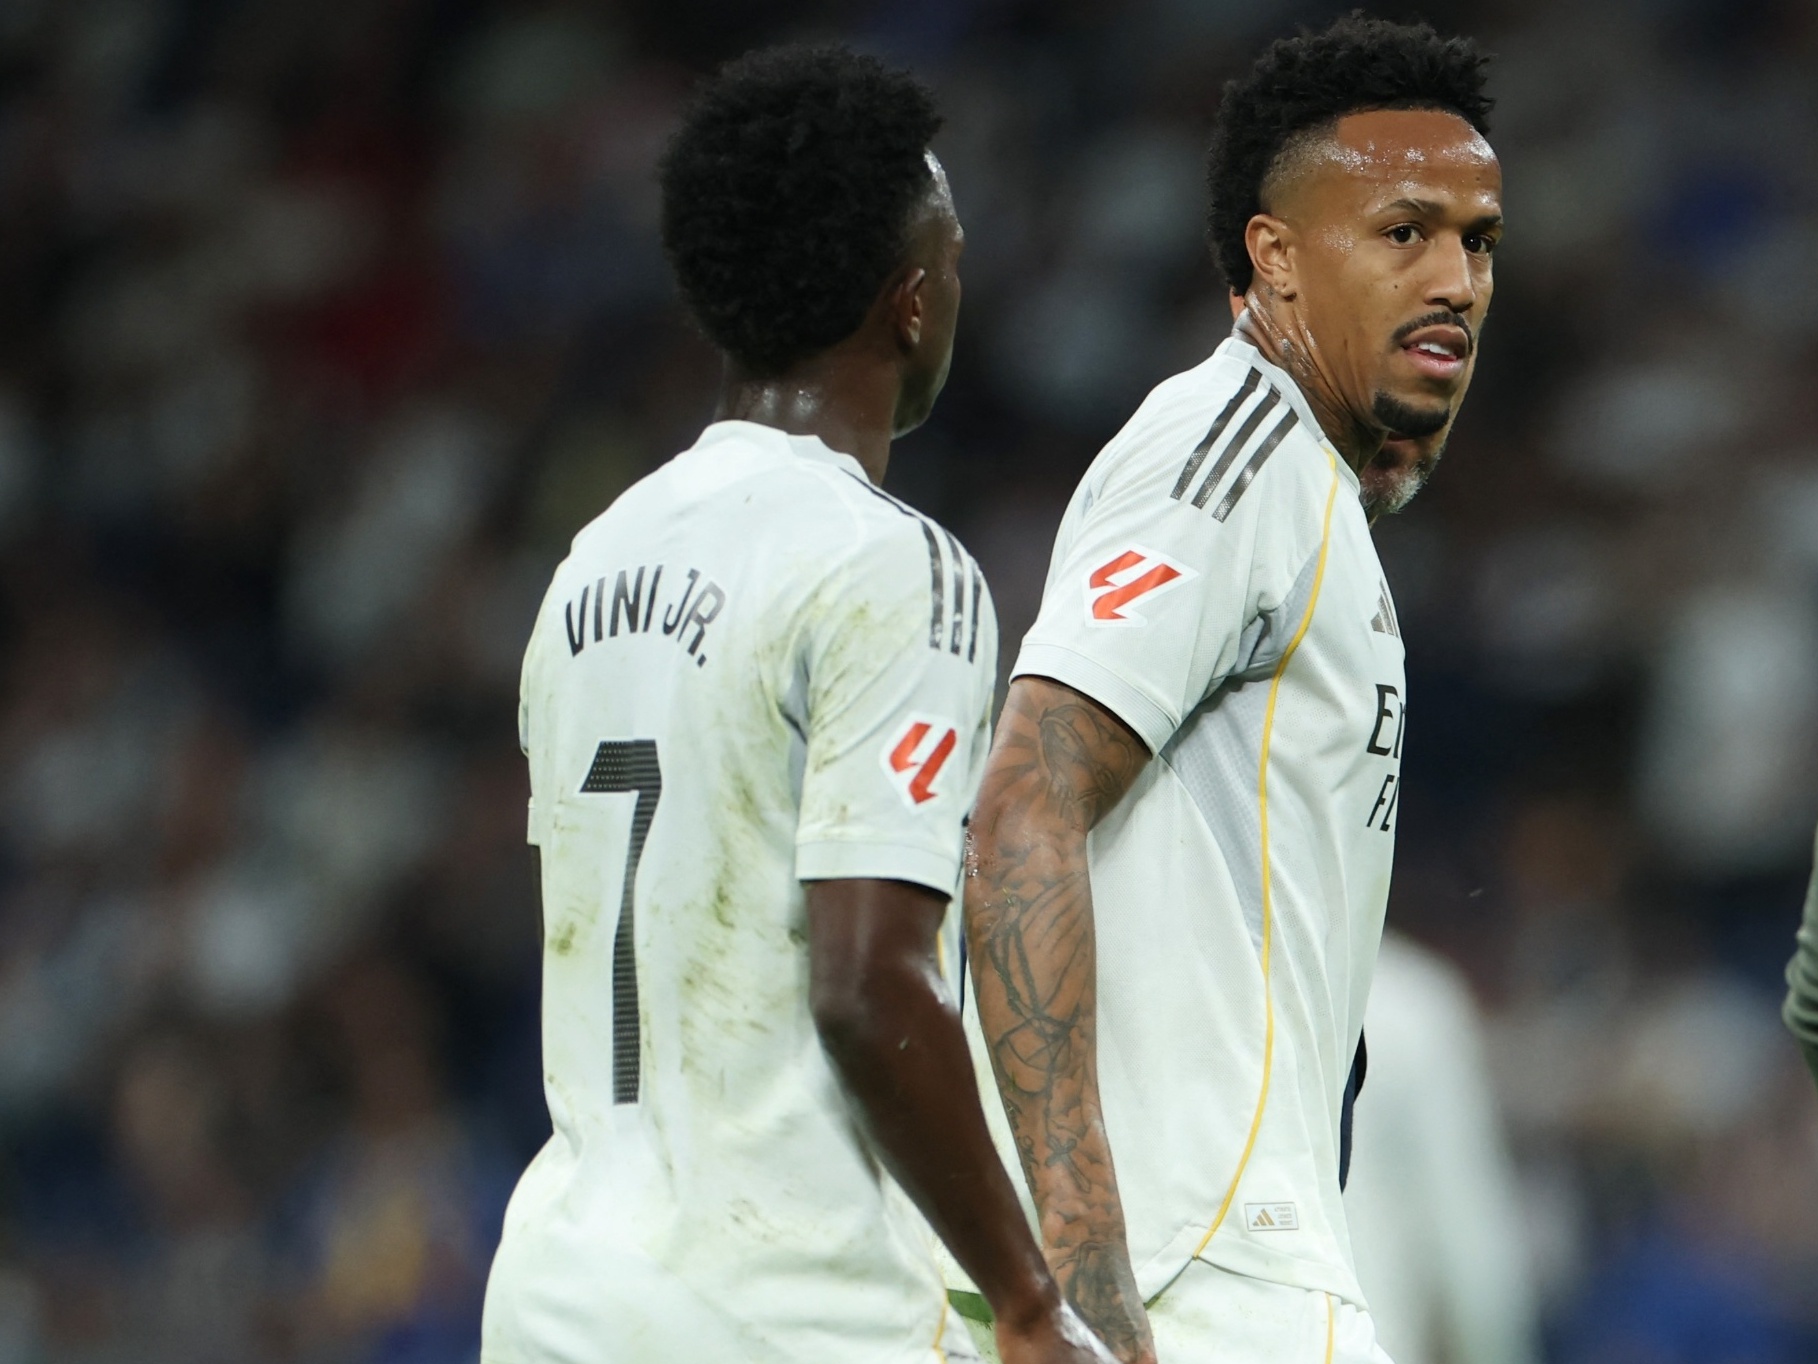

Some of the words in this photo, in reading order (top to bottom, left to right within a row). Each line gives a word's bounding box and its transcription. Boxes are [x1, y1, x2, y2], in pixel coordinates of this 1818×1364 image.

[565, 564, 664, 658] VINI
[662, 567, 727, 669] JR.
[578, 738, 662, 1104] 7
